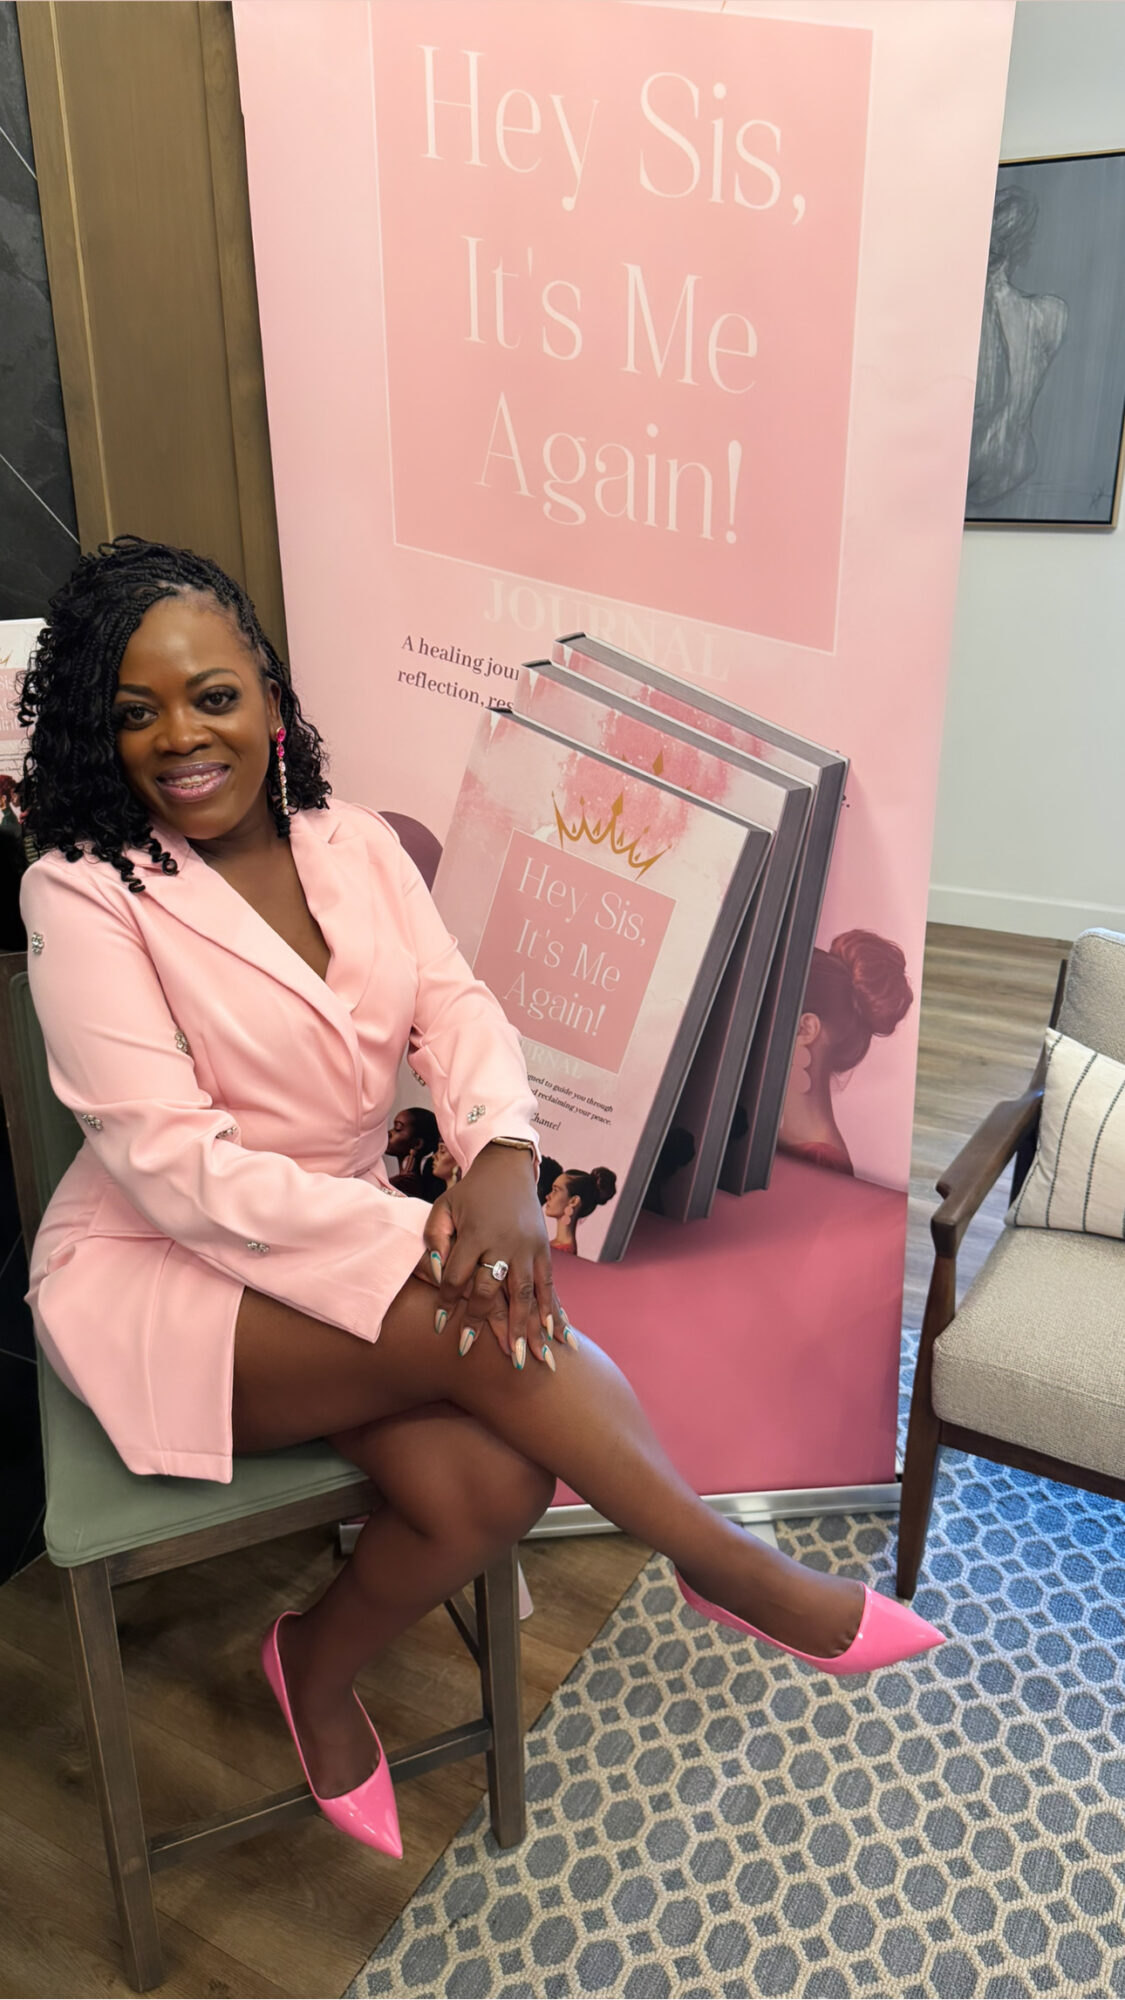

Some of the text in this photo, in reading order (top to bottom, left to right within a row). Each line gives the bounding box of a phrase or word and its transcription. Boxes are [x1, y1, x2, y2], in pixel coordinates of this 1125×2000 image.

[417, 44, 806, 225] Hey Sis,
[460, 235, 759, 395] It's Me
[473, 391, 743, 545] Again!
[401, 635, 414, 652] A
[418, 637, 485, 675] healing
[484, 579, 728, 682] JOURNAL
[397, 670, 485, 708] reflection,
[517, 857, 646, 947] Hey Sis,
[515, 918, 621, 992] It's Me
[503, 971, 606, 1037] Again!
[537, 1092, 576, 1112] reclaiming
[574, 1107, 591, 1118] your
[544, 1080, 553, 1088] to
[552, 1085, 573, 1096] guide
[571, 1092, 587, 1102] you
[586, 1097, 613, 1112] through
